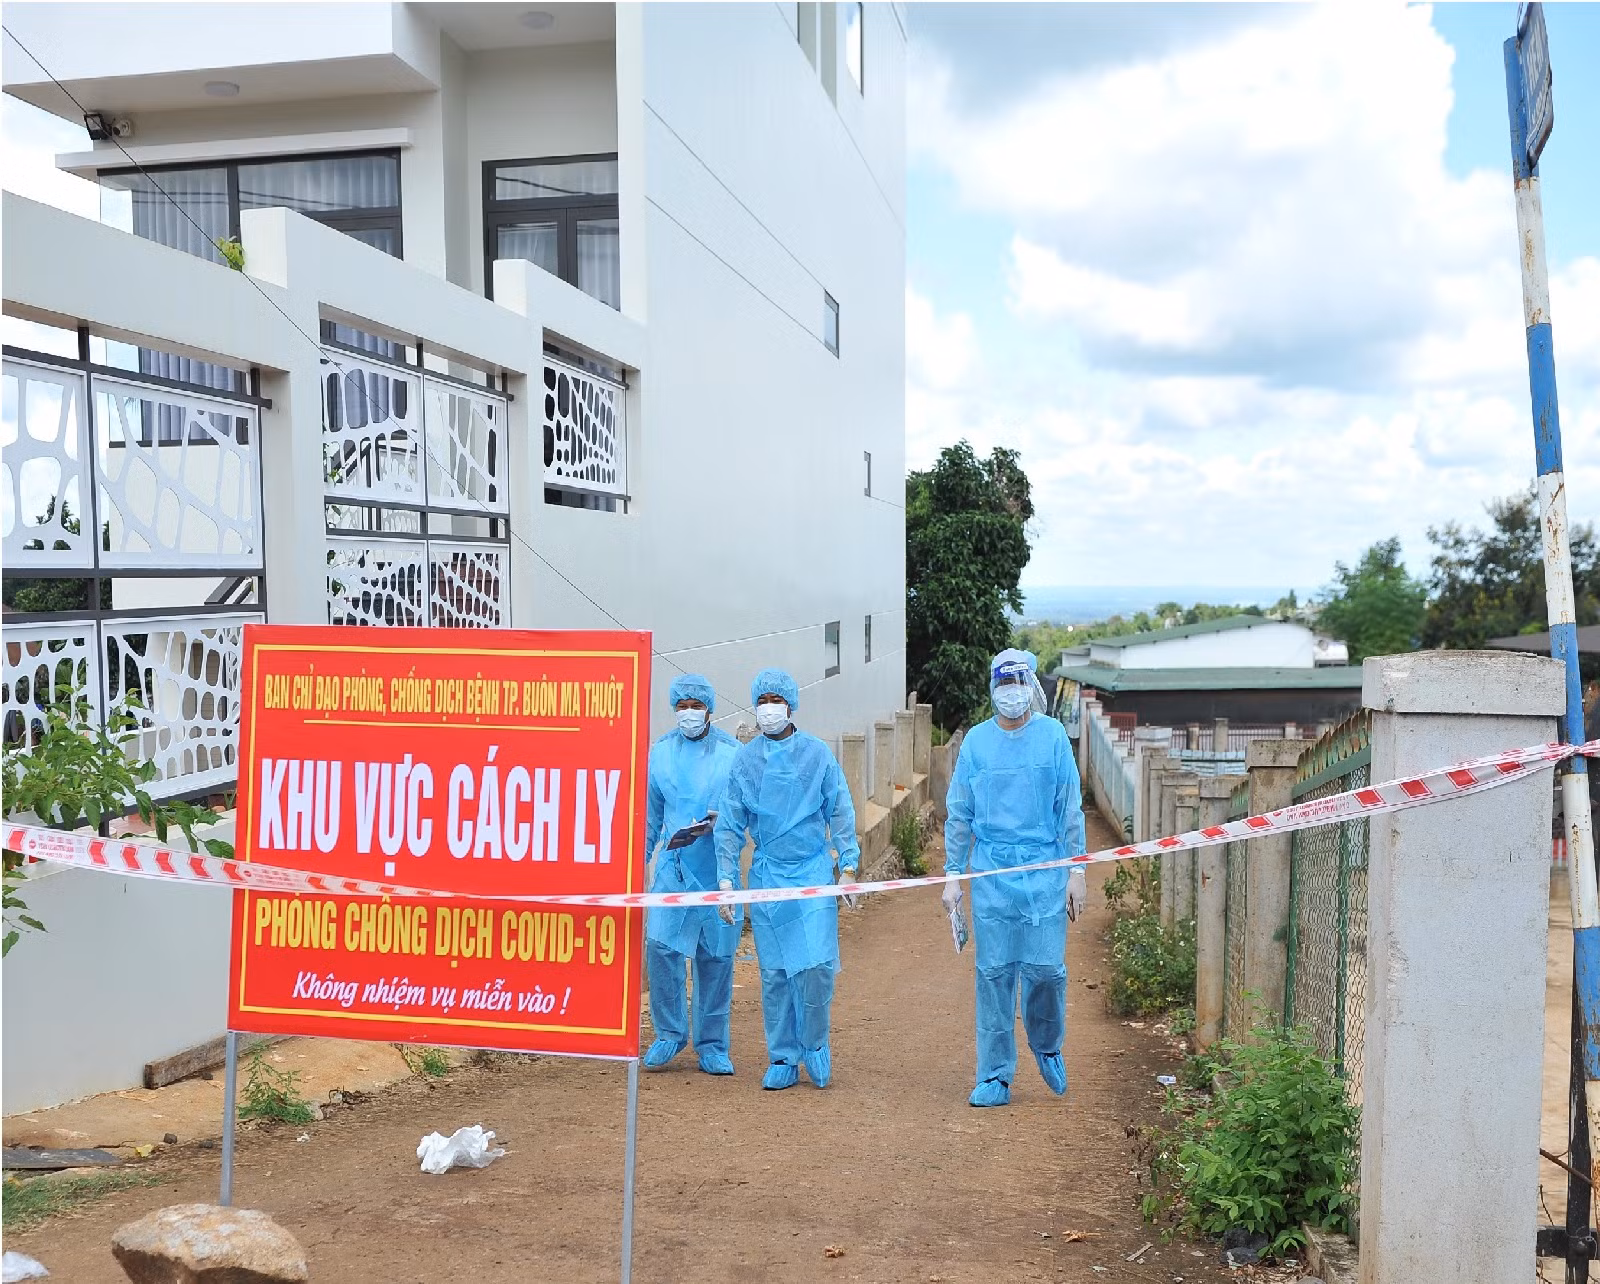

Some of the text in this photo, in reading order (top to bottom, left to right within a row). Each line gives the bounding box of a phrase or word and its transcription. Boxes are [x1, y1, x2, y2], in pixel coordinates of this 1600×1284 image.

[265, 664, 624, 726] BAN CHỈ ĐẠO PHÒNG, CHỐNG DỊCH BỆNH TP. BUÔN MA THUỘT
[259, 745, 622, 877] KHU VỰC CÁCH LY
[434, 907, 494, 968] DỊCH
[501, 910, 616, 966] COVID-19
[292, 971, 359, 1008] Không
[361, 977, 425, 1011] nhiệm
[430, 985, 456, 1014] vụ
[459, 978, 512, 1012] miễn
[517, 985, 556, 1014] vào
